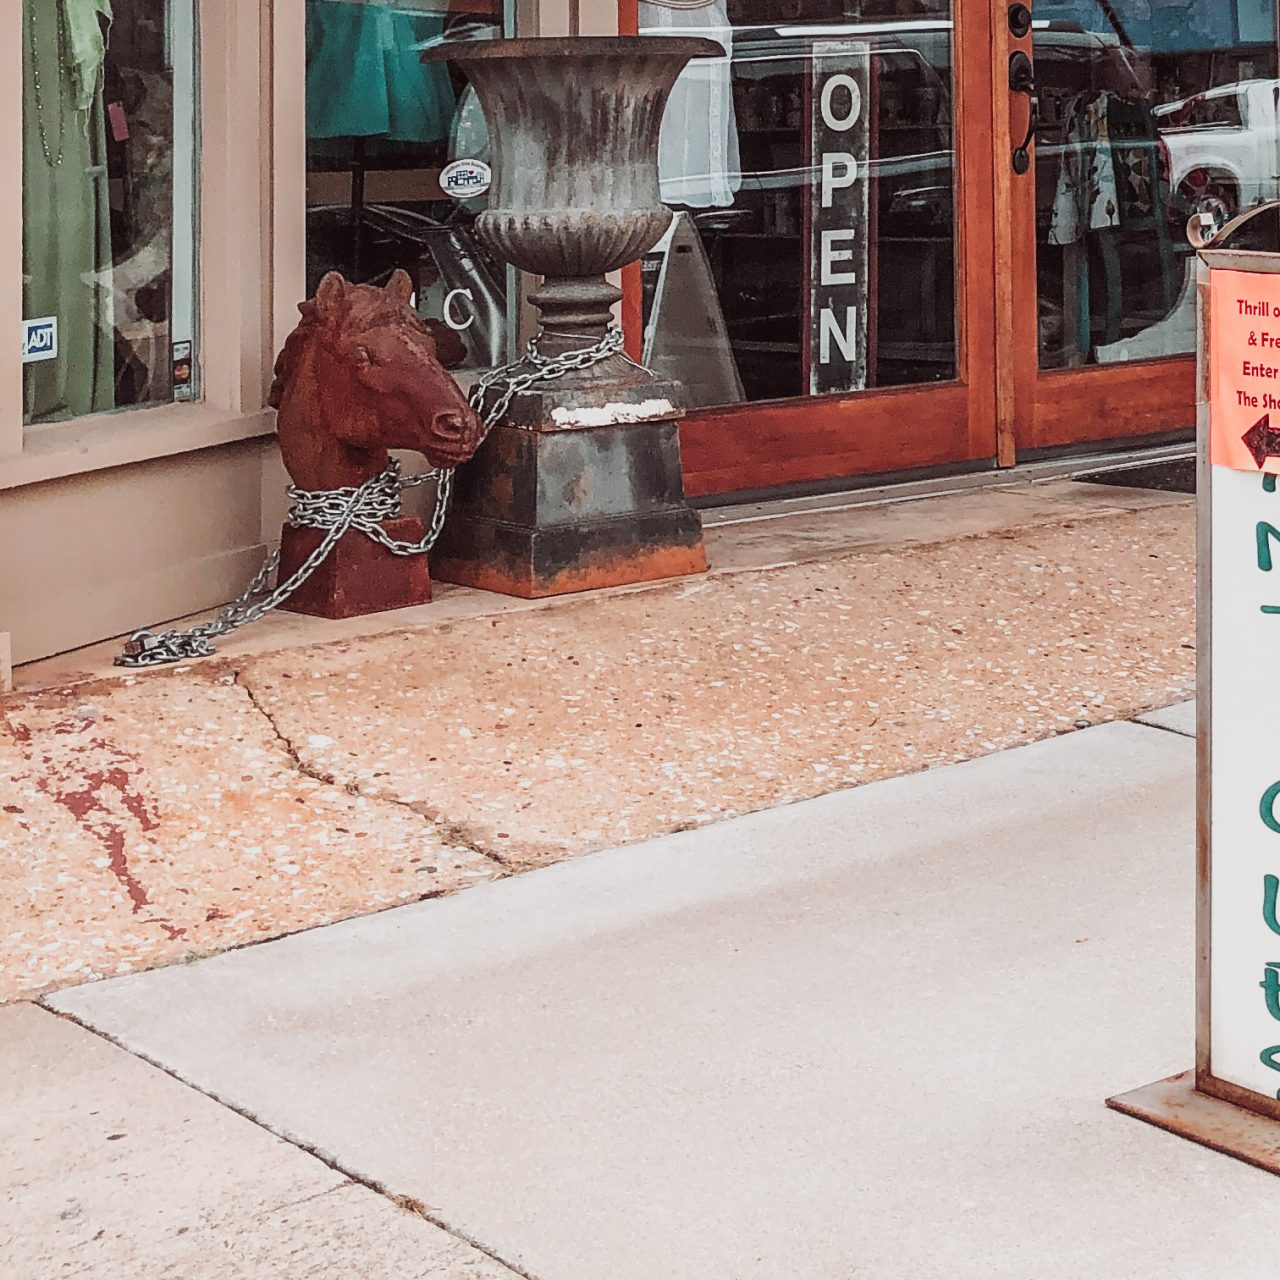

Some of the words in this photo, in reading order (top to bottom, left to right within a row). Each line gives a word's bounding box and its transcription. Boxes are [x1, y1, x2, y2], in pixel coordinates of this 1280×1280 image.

[819, 73, 862, 366] OPEN
[1236, 299, 1269, 317] Thrill
[28, 327, 53, 350] ADT
[1247, 331, 1257, 347] &
[1243, 361, 1278, 380] Enter
[1236, 390, 1258, 407] The
